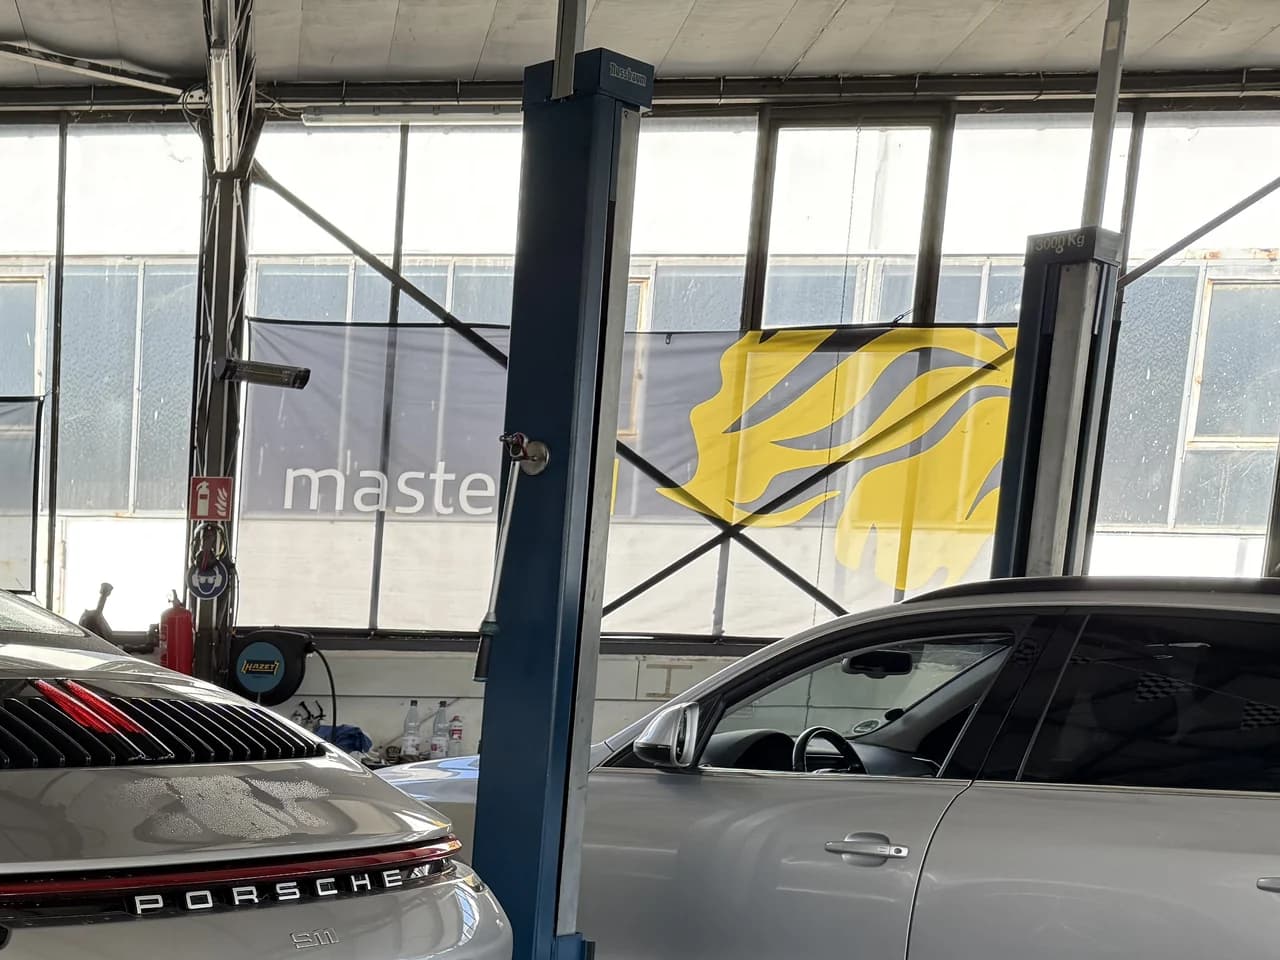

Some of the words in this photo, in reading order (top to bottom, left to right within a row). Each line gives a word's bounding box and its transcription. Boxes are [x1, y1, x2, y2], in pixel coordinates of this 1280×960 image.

[283, 461, 497, 515] maste
[134, 869, 403, 915] PORSCHE
[290, 928, 340, 949] 911
